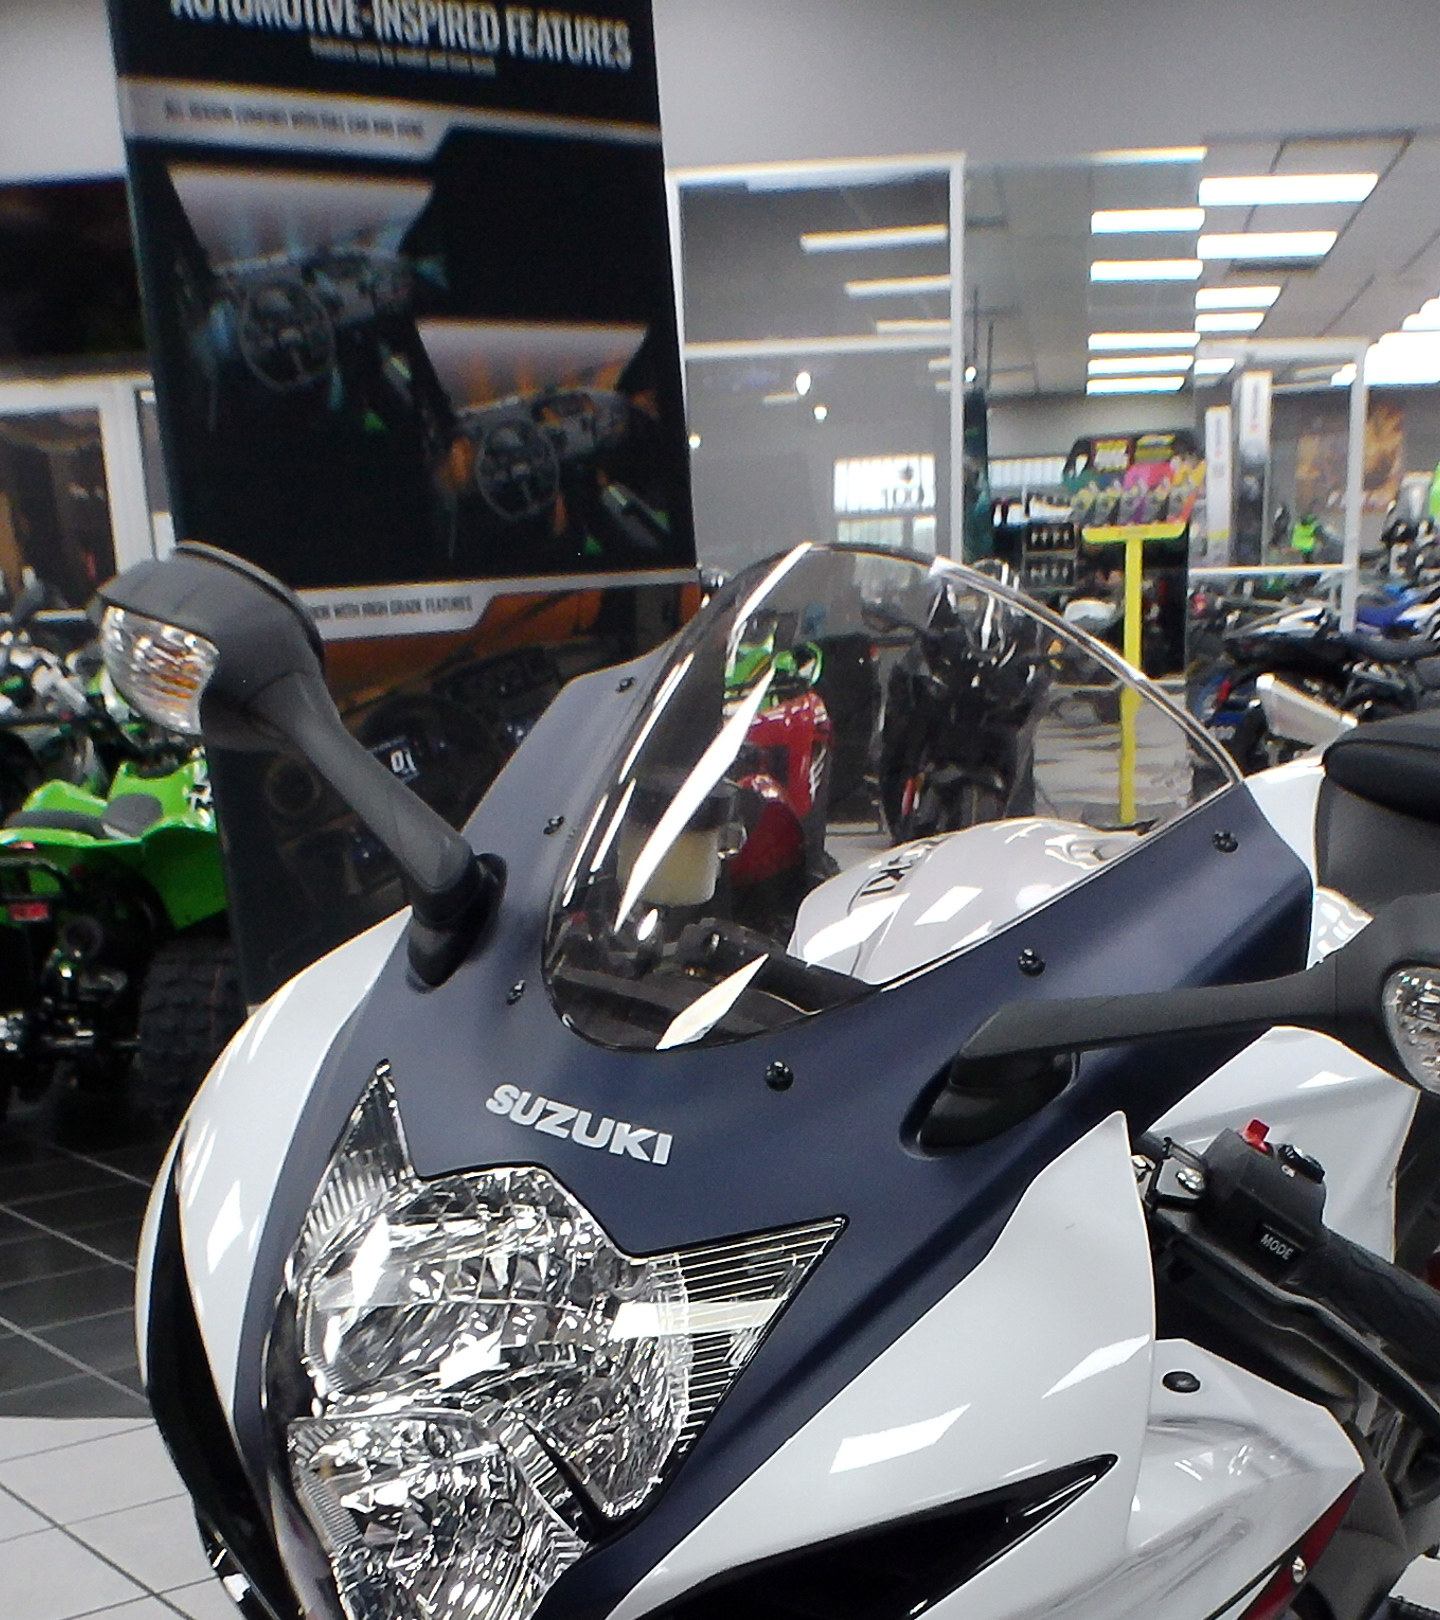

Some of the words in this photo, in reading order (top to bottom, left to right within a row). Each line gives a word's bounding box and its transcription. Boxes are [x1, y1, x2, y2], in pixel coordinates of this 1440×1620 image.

[505, 6, 633, 71] FEATURES
[424, 595, 473, 614] FEATURES
[485, 1083, 673, 1166] SUZUKI
[1260, 1233, 1294, 1261] MODE
